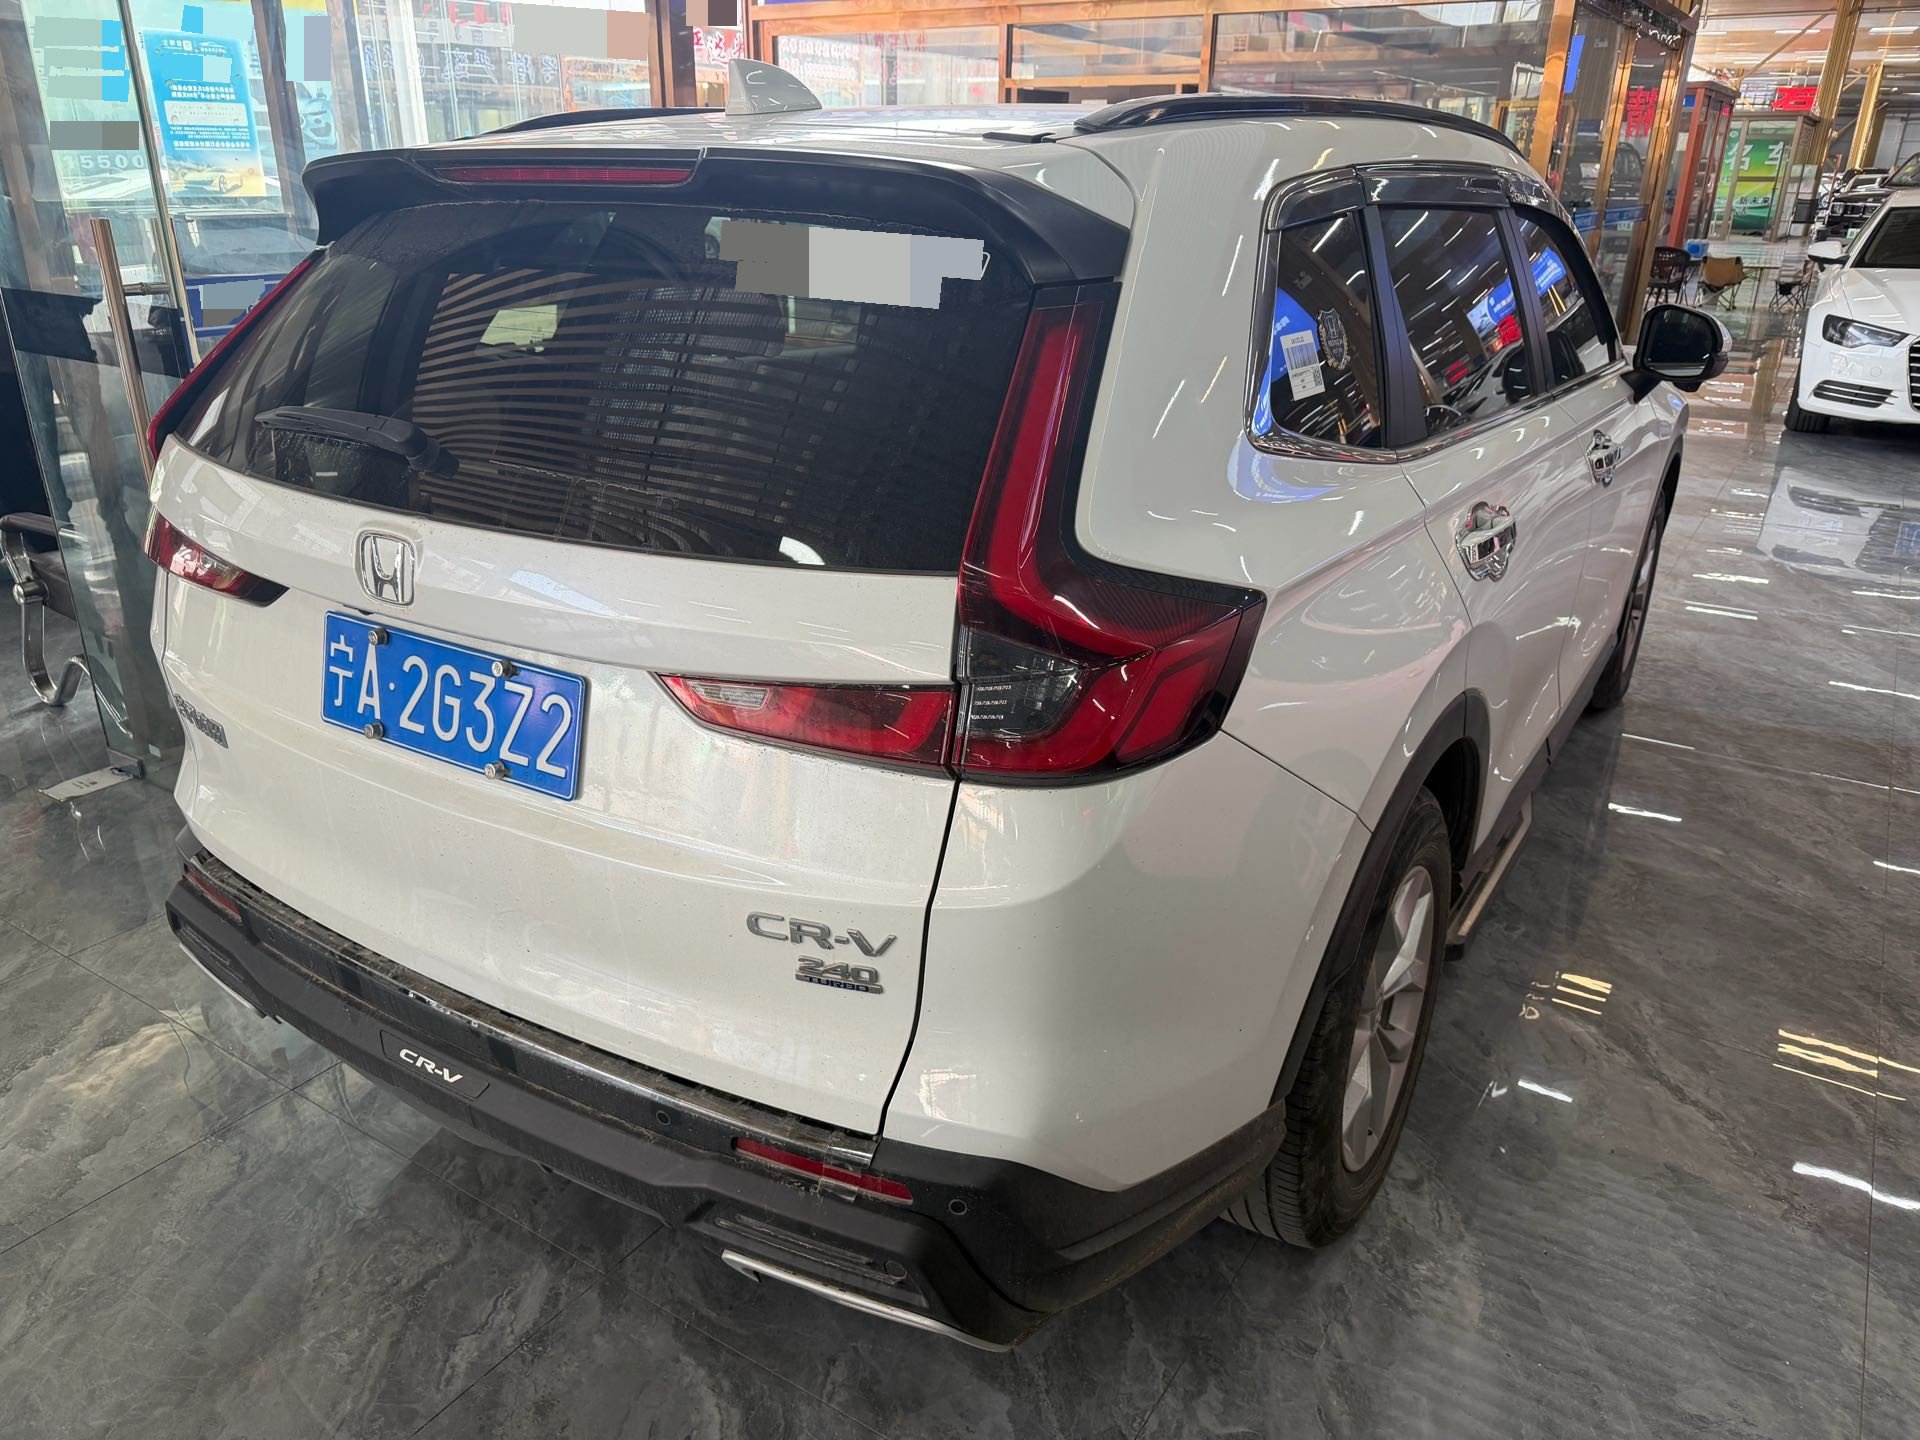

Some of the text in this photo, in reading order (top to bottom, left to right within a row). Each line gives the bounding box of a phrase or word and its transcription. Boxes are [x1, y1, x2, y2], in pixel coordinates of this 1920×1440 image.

[746, 910, 898, 958] CR-V
[798, 955, 879, 984] 240
[399, 1048, 464, 1083] CR-V
